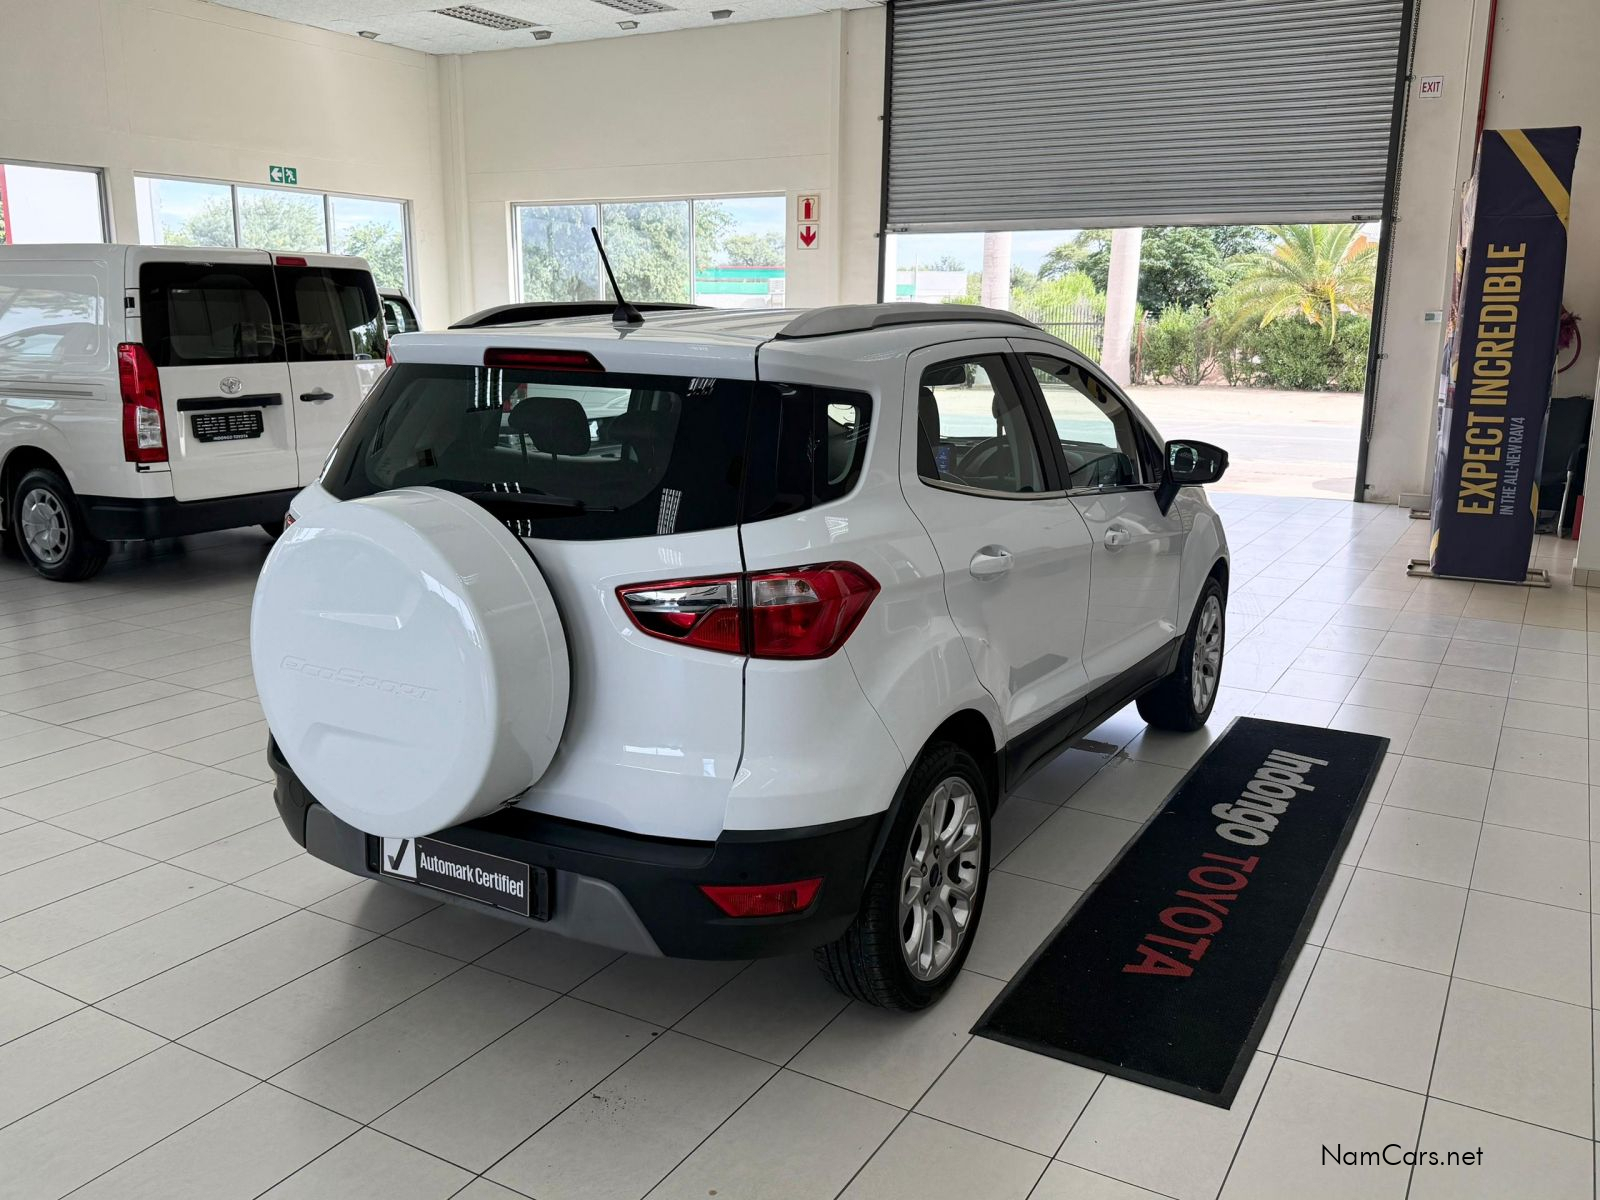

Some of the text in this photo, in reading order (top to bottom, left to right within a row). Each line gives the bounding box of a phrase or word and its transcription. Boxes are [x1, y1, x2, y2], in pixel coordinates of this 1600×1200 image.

[1421, 81, 1441, 93] EXIT
[1457, 243, 1527, 515] EXPECT INCREDIBLE
[1500, 416, 1526, 516] IN THE ALL-NEW RAV4
[420, 852, 524, 898] Automark Certified
[1122, 749, 1329, 977] Indongo TOYOTA
